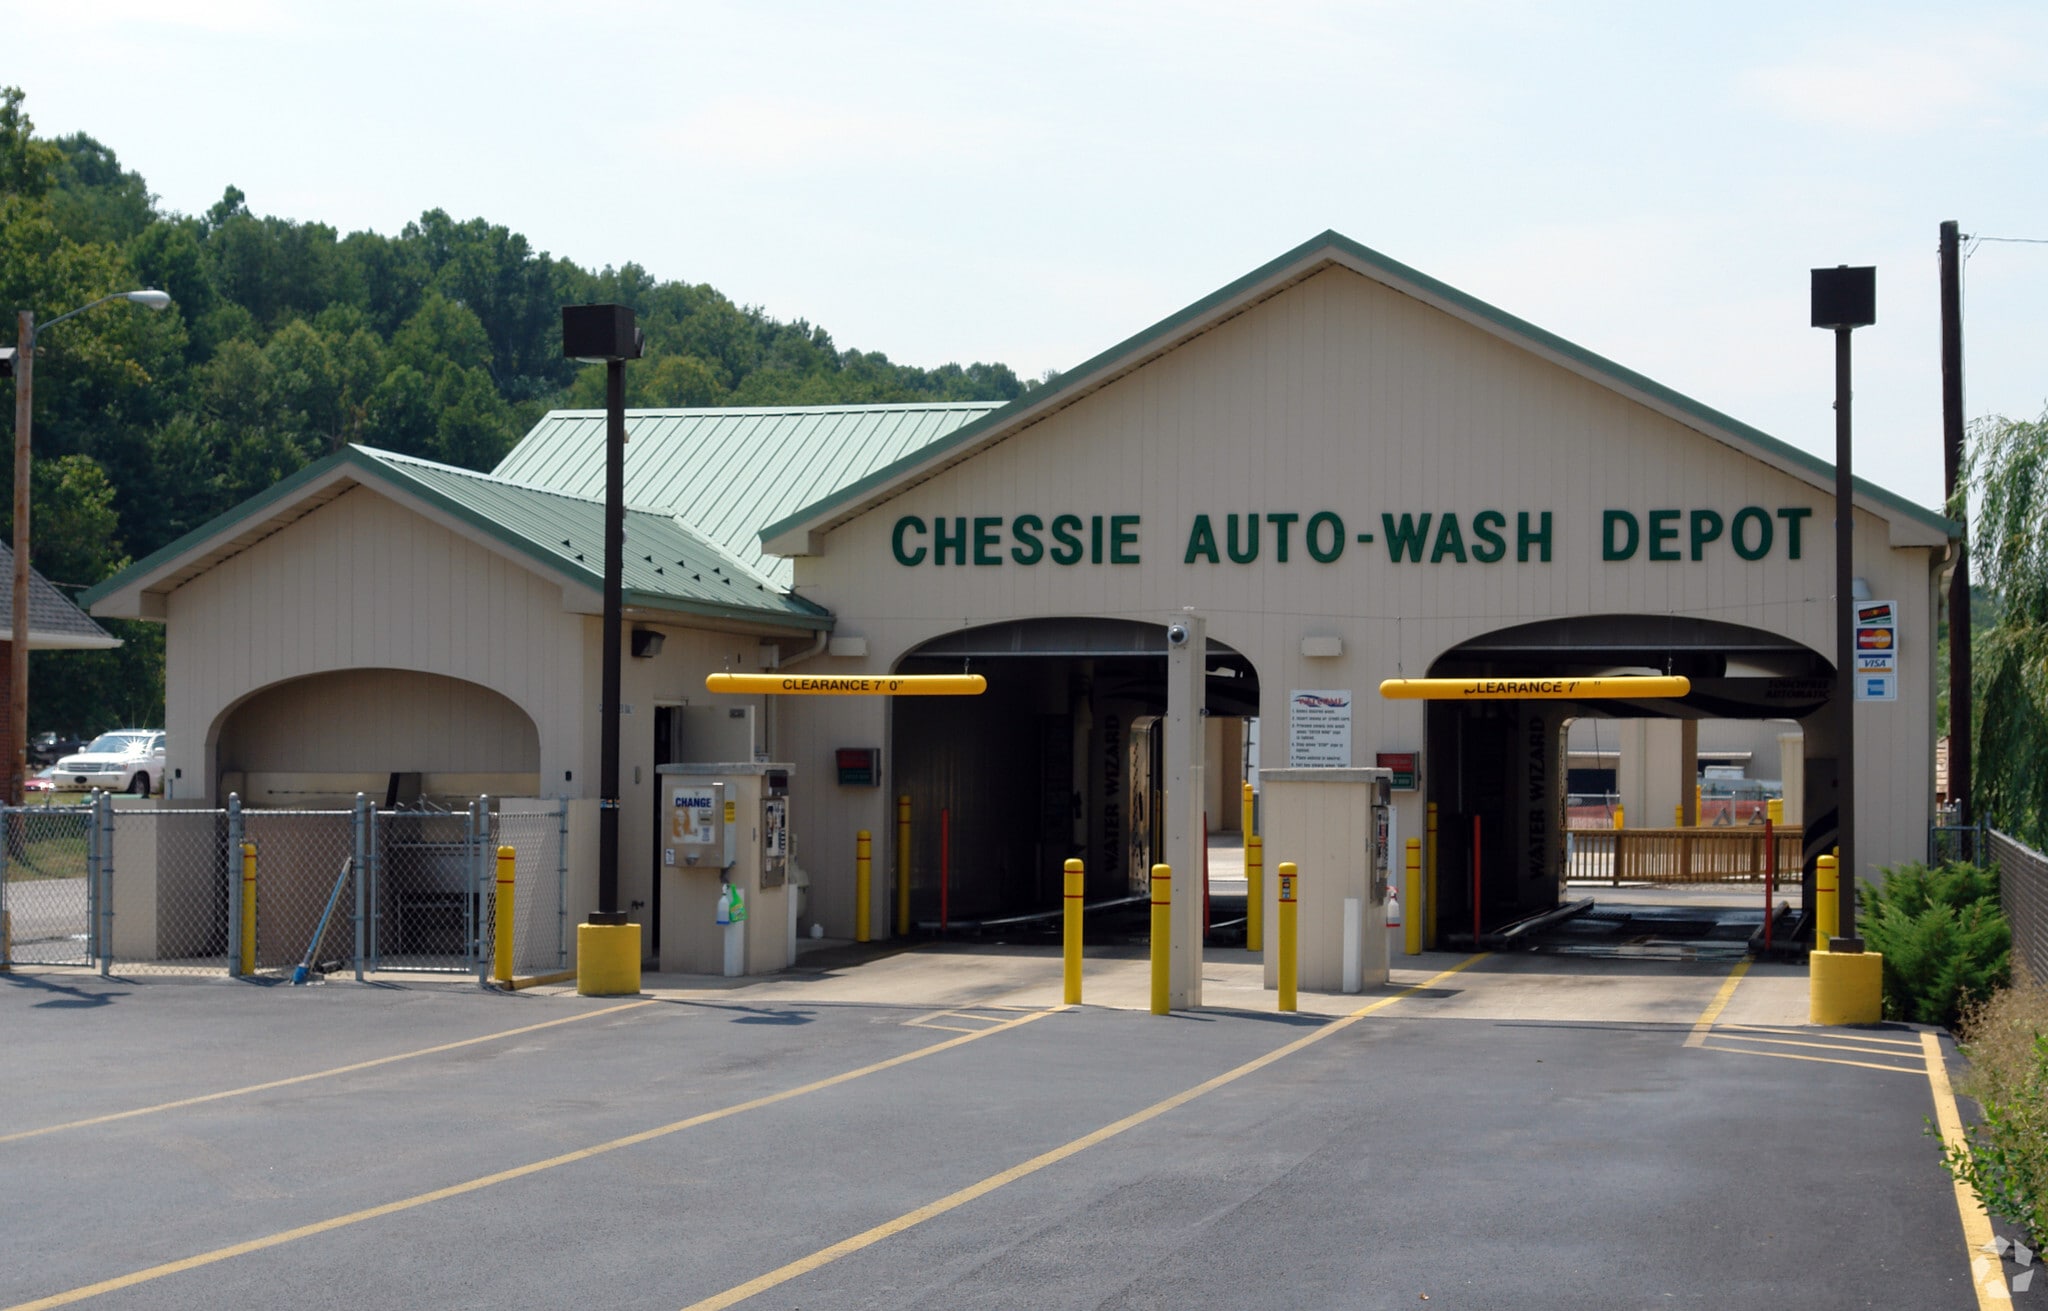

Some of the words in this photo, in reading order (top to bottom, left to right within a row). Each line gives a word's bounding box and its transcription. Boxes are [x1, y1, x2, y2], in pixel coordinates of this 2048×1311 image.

[890, 513, 1142, 568] CHESSIE
[1183, 509, 1554, 566] AUTO-WASH
[1601, 505, 1815, 562] DEPOT
[782, 679, 870, 691] CLEARANCE
[874, 680, 886, 691] 7'
[889, 680, 904, 692] 0"
[1864, 659, 1886, 667] VISA
[1104, 714, 1121, 797] WIZARD
[1528, 715, 1546, 802] WIZARD
[675, 797, 712, 808] CHANGE
[1104, 803, 1121, 873] WATER
[1528, 809, 1546, 881] WATER
